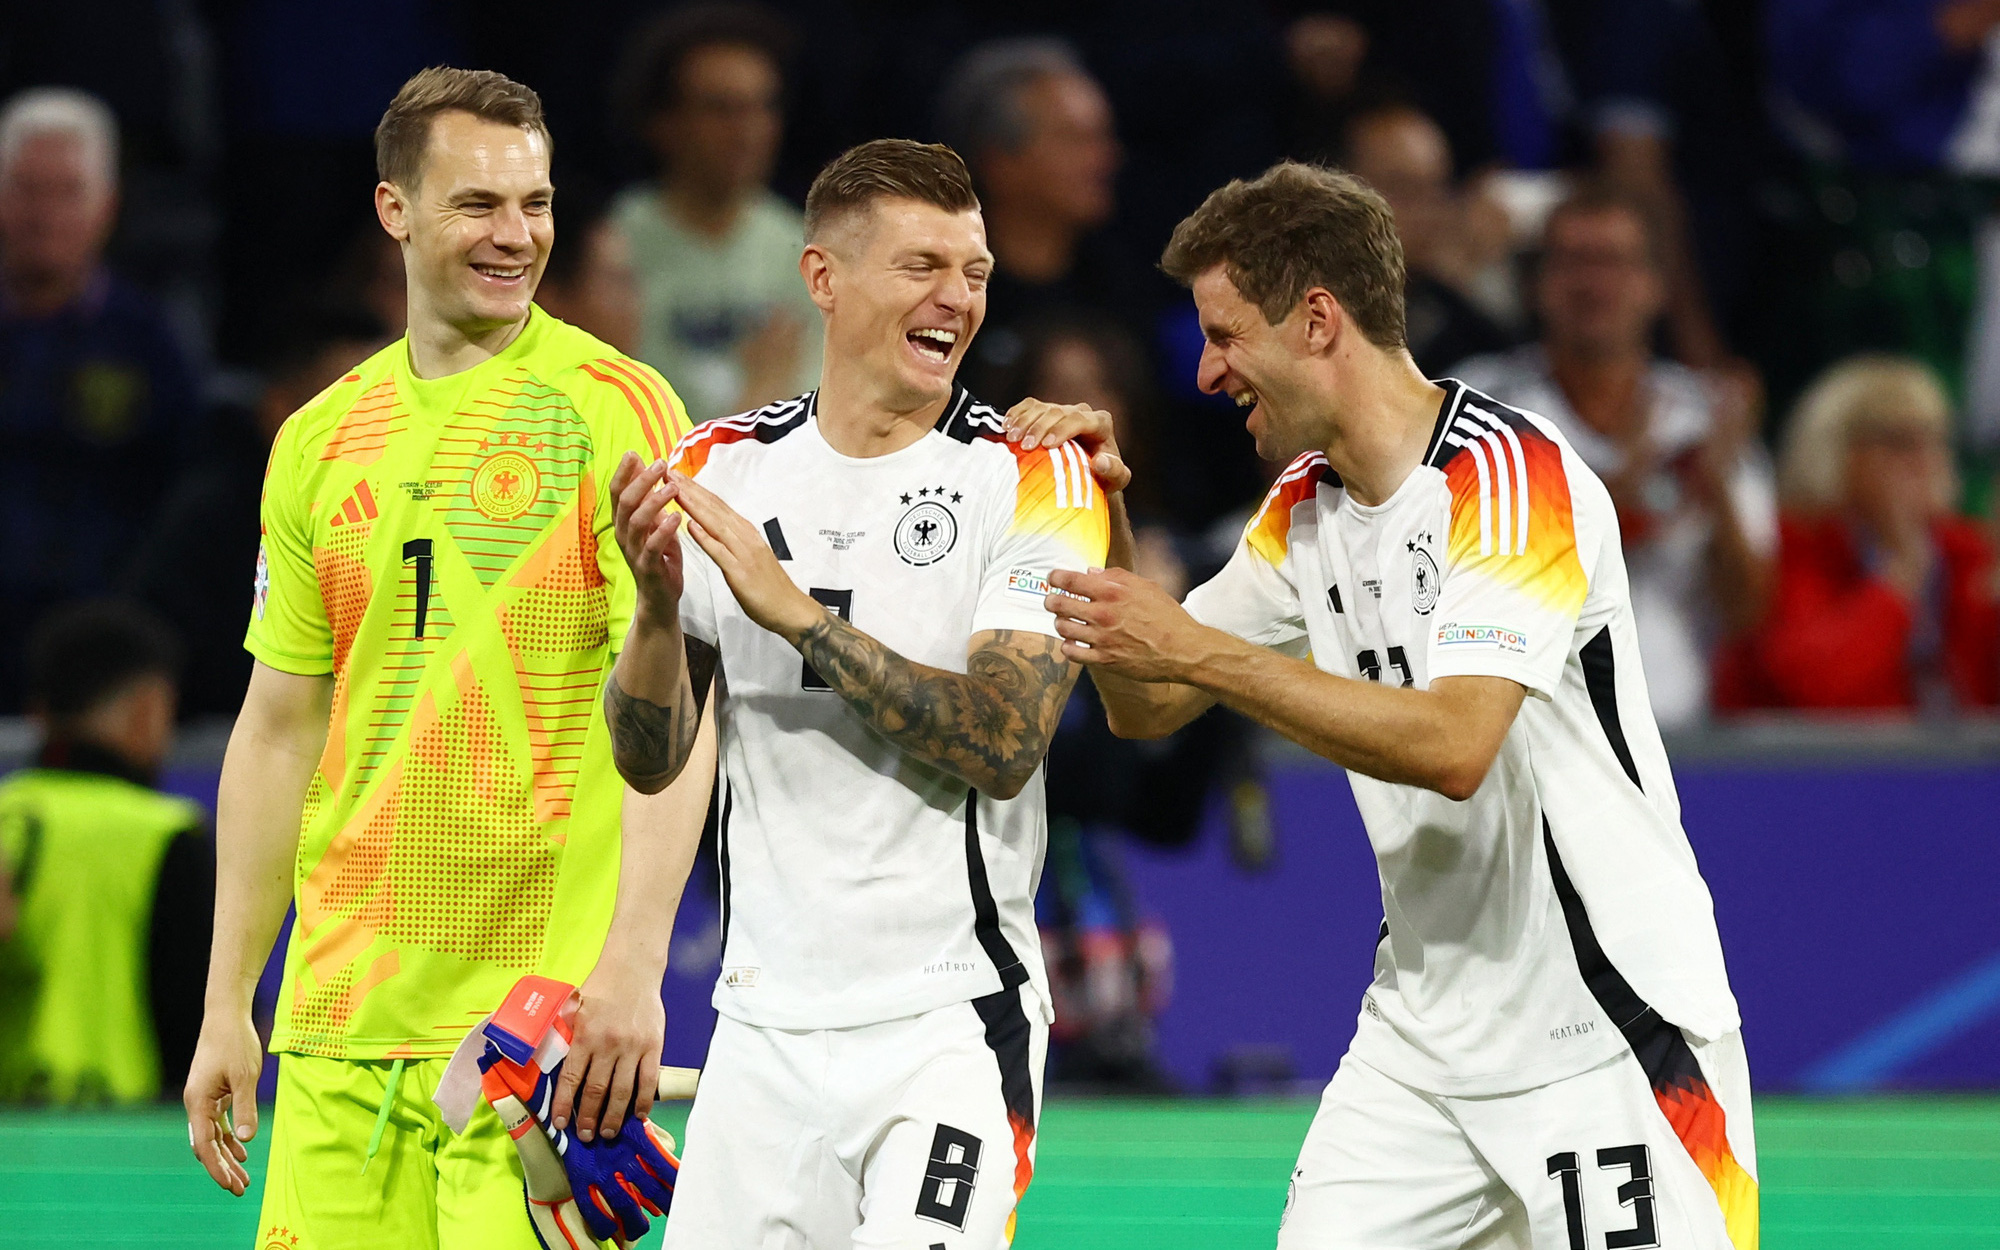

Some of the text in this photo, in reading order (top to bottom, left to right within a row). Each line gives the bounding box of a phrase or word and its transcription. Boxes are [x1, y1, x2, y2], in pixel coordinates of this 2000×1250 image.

[487, 459, 528, 474] DEUTSCHER
[908, 509, 945, 523] DEUTSCHER
[1010, 568, 1032, 577] UEFA
[402, 538, 435, 641] 1
[1438, 622, 1458, 631] UEFA
[915, 1122, 984, 1234] 8
[1546, 1143, 1661, 1250] 13
